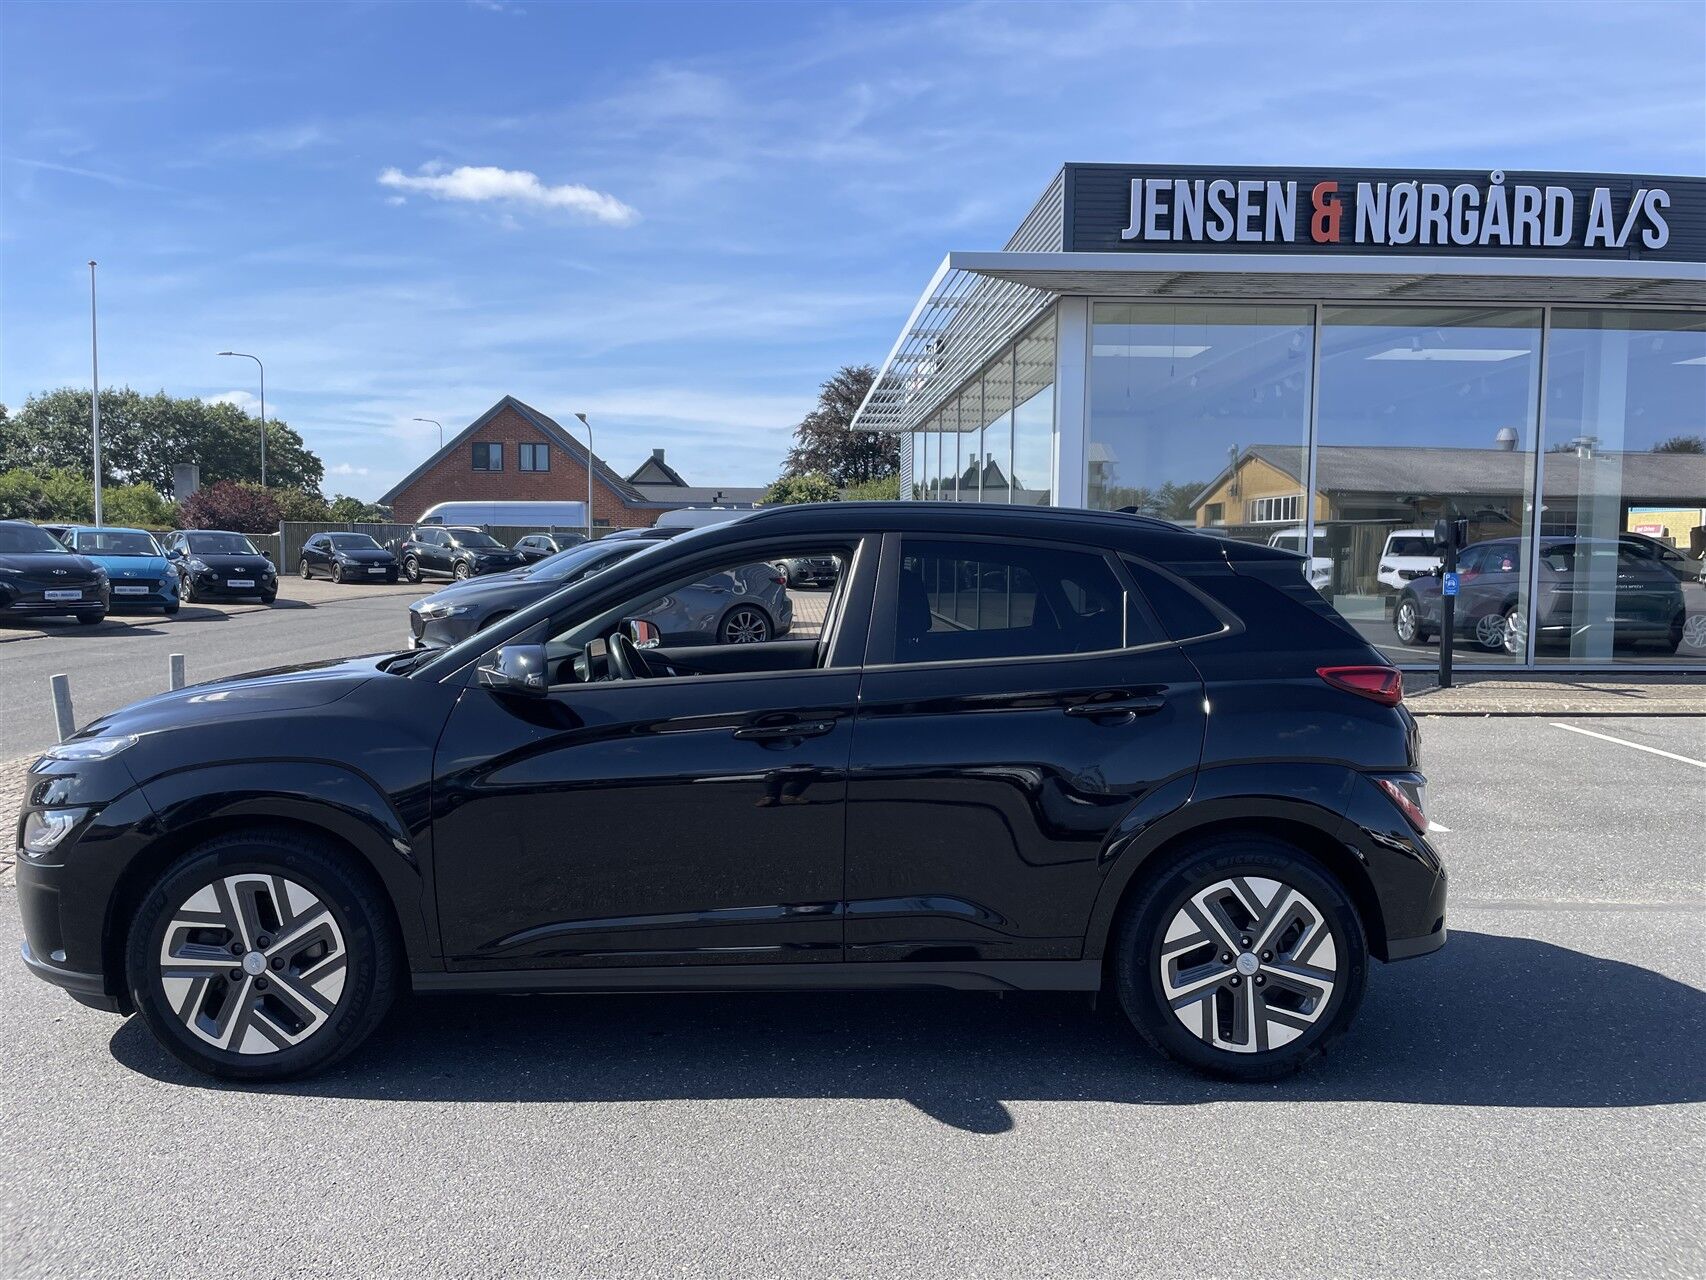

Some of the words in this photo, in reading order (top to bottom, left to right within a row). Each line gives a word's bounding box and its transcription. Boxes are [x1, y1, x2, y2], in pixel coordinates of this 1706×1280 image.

[1121, 178, 1297, 242] JENSEN
[1311, 181, 1343, 243] &
[1354, 169, 1574, 247] NØRGÅRD
[1584, 187, 1671, 250] A/S
